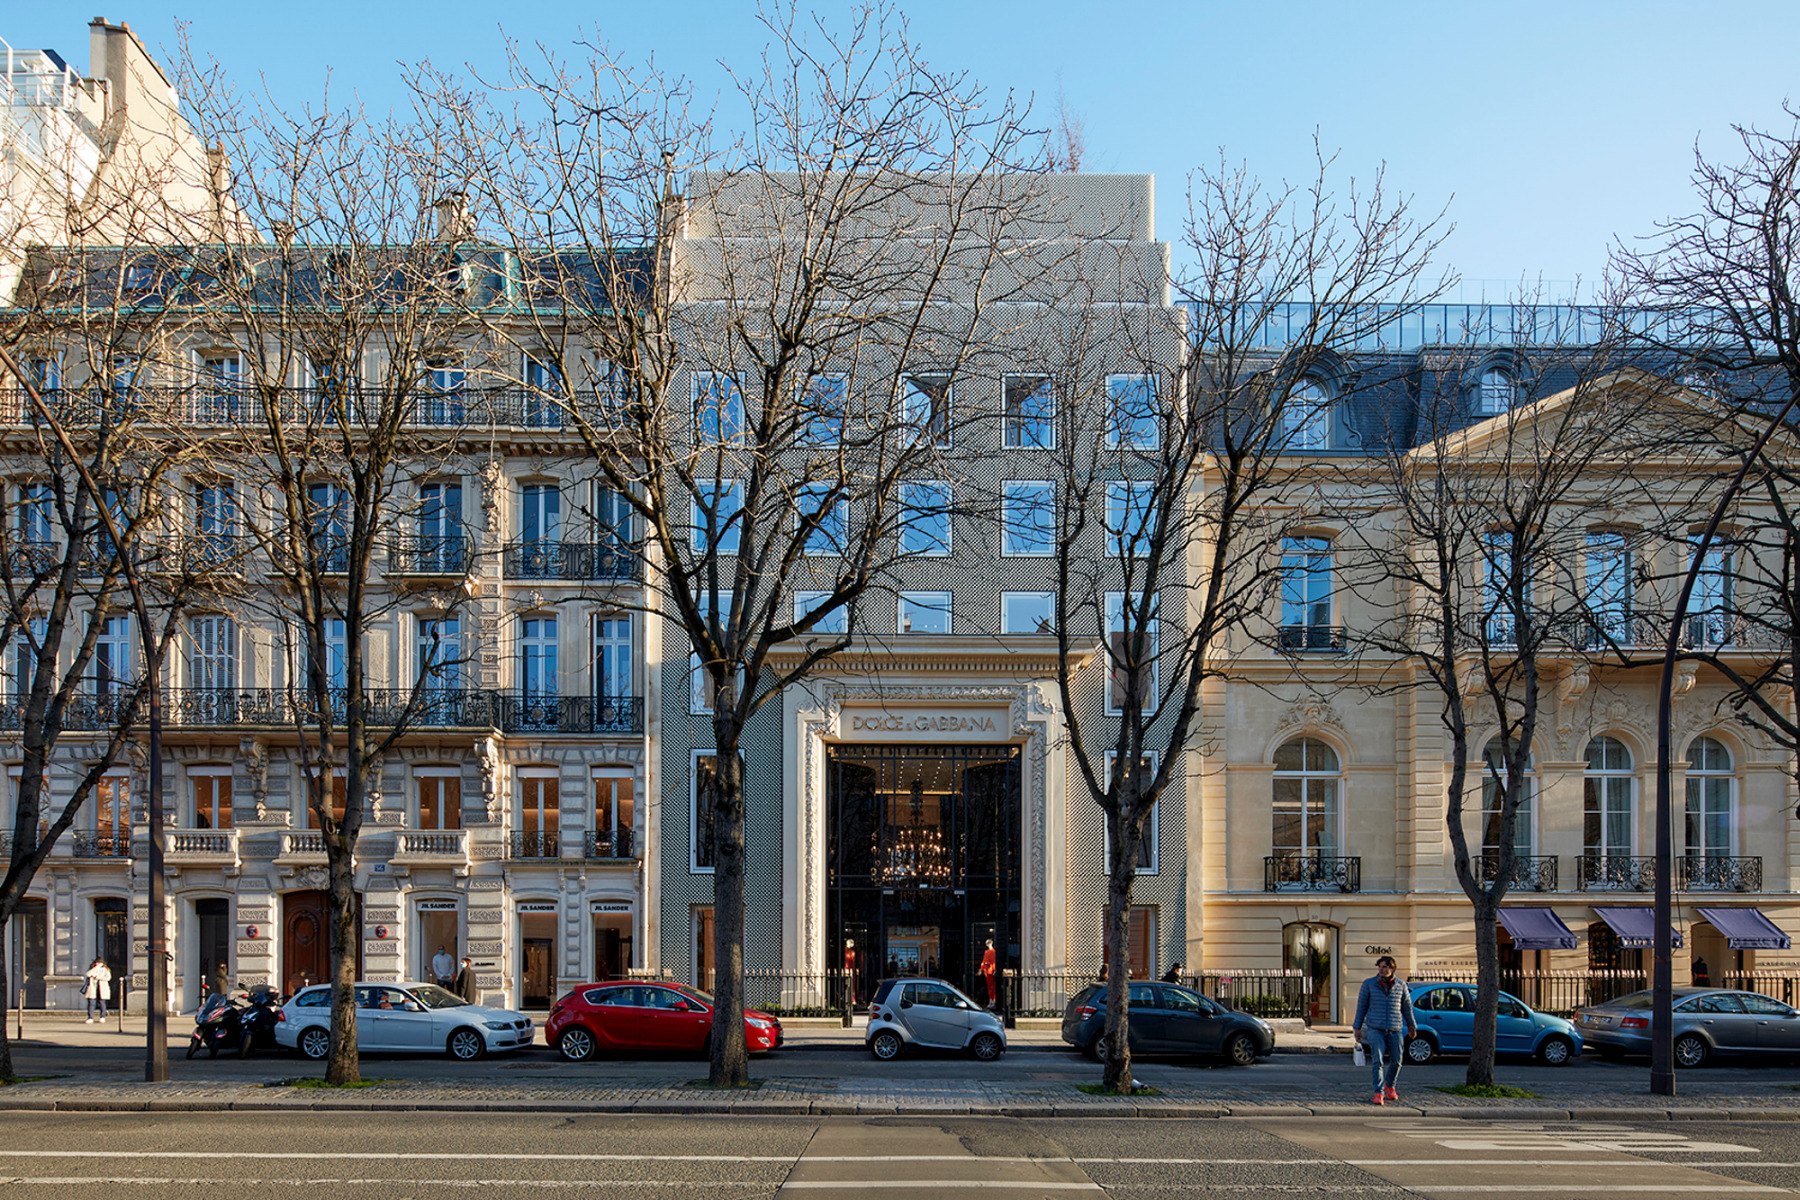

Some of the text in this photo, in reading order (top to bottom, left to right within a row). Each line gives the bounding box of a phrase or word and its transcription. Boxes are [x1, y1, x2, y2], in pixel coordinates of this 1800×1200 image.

[853, 715, 903, 731] DOLCE
[914, 715, 996, 732] GABBANA
[1365, 945, 1392, 955] Chloé
[1363, 1121, 1761, 1153] BUS
